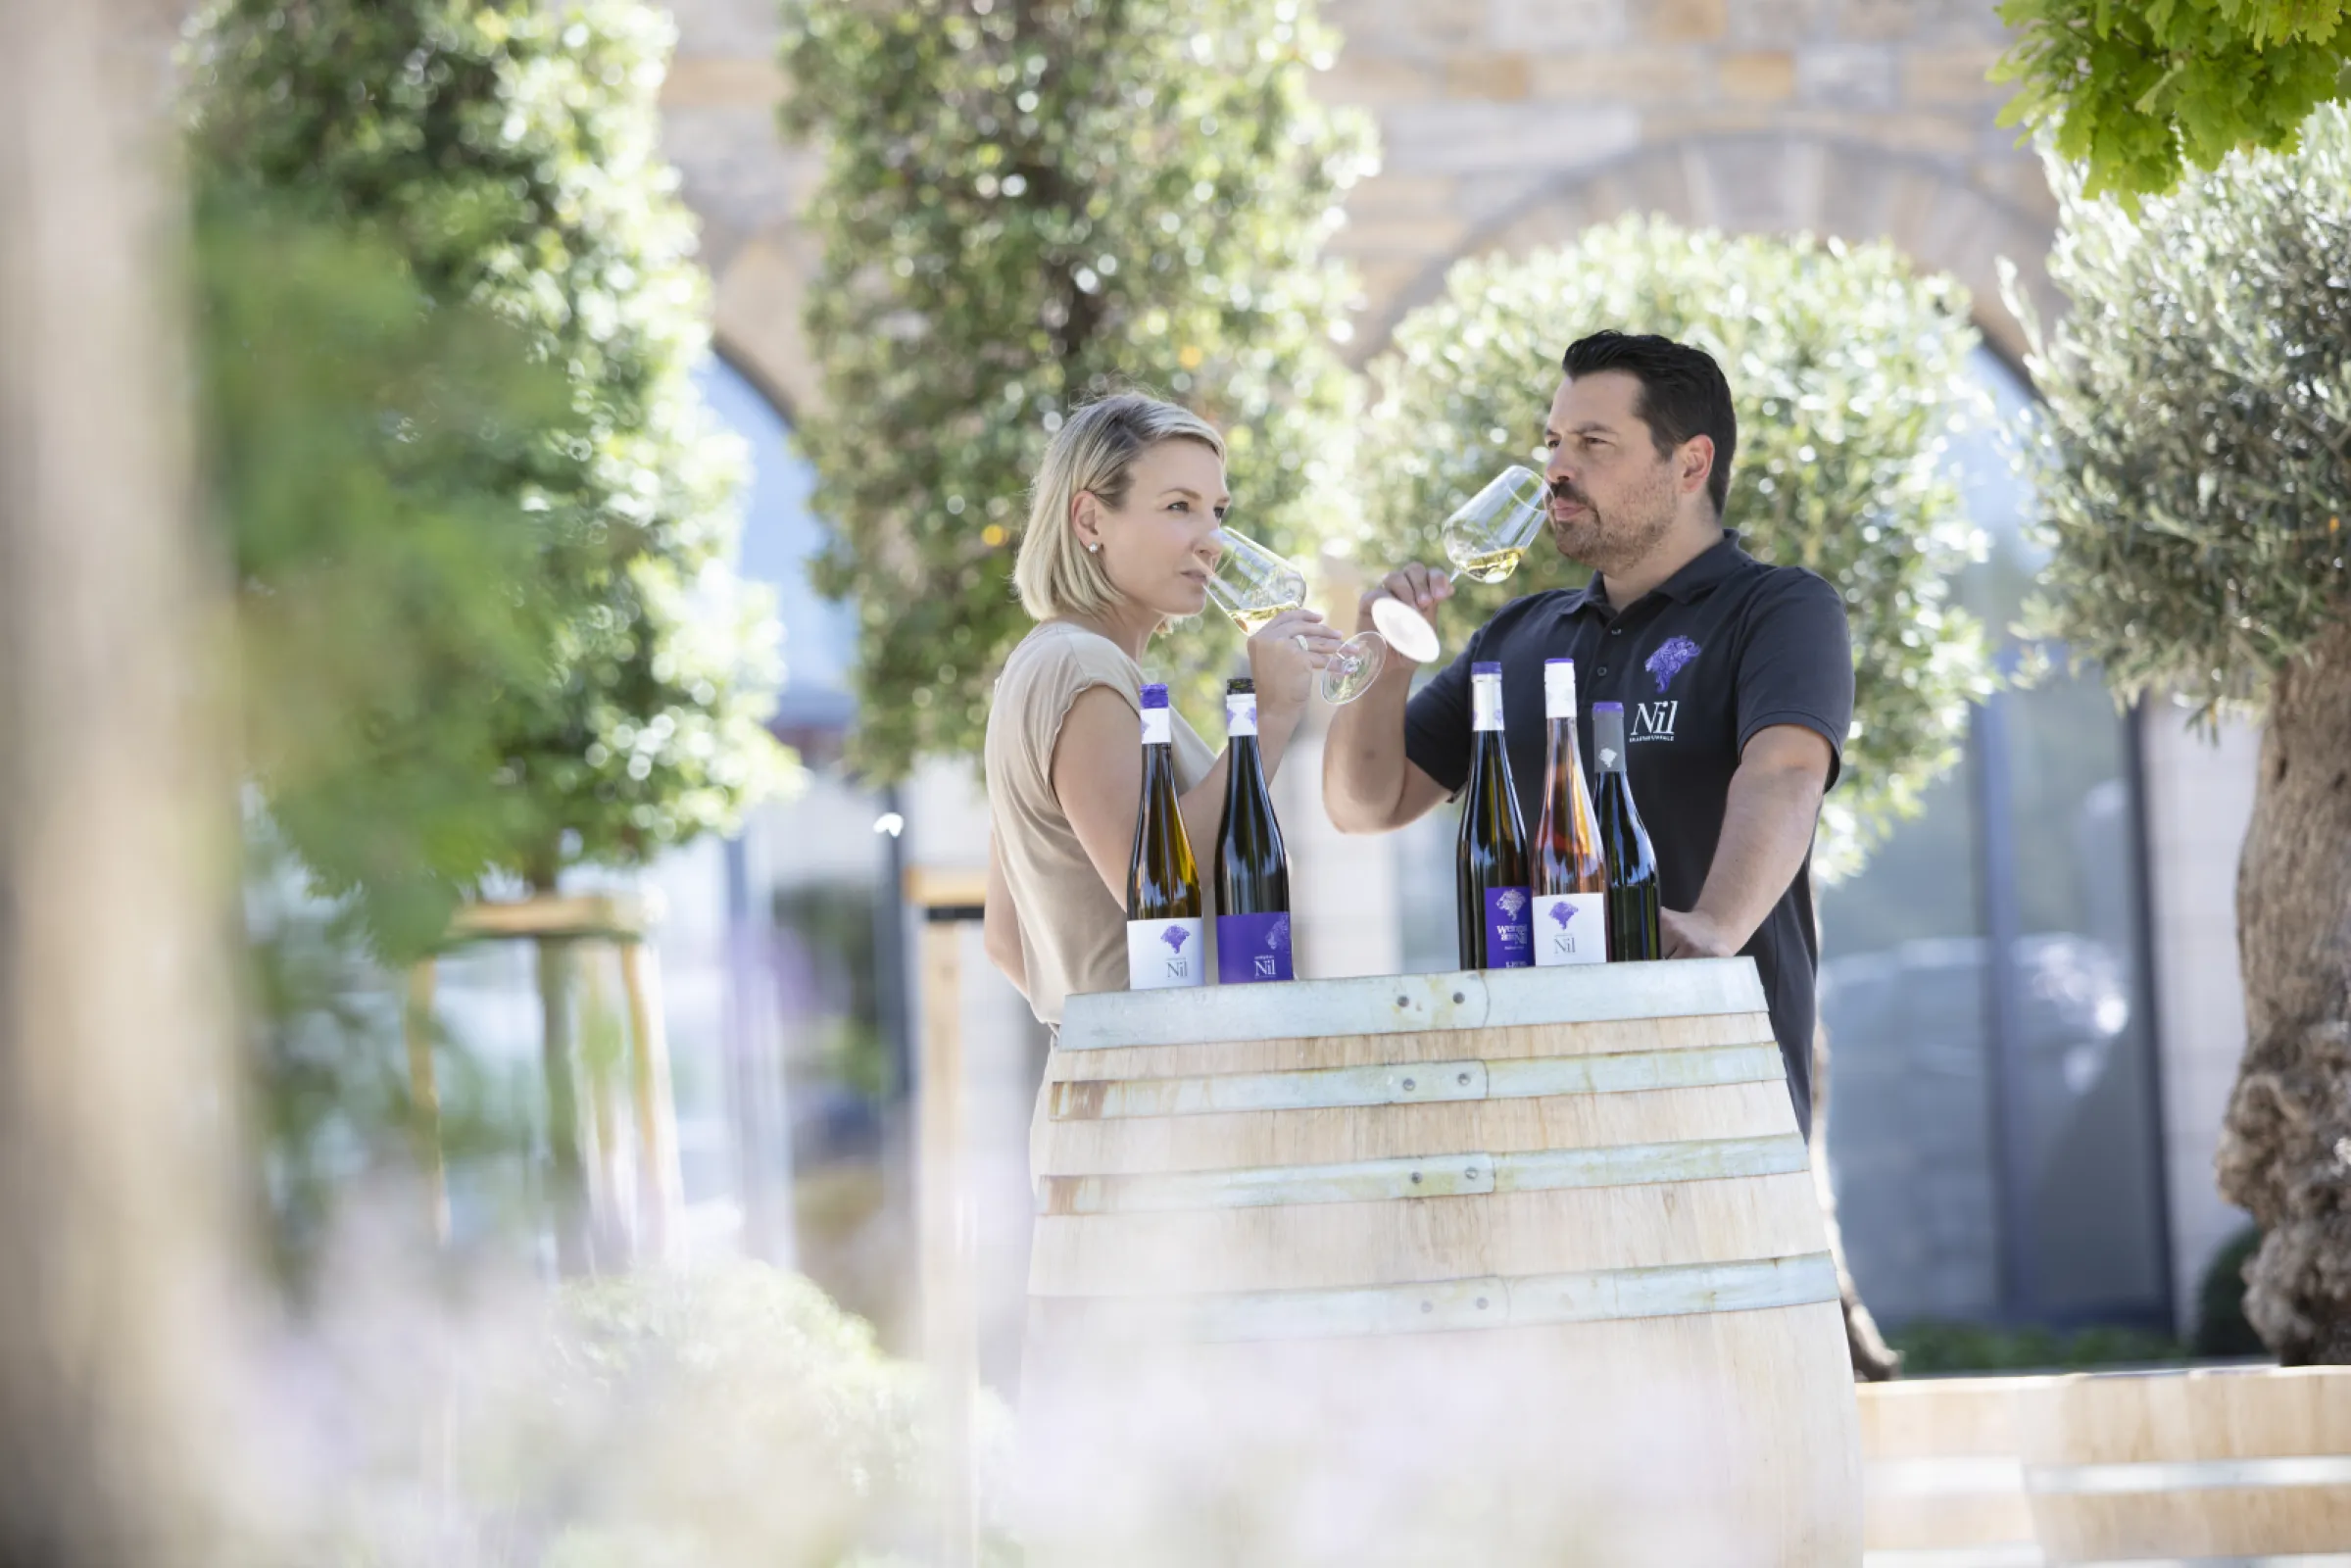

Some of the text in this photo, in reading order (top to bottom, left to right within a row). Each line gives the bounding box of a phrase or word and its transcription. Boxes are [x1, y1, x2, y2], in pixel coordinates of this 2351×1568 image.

[1630, 701, 1678, 735] Nil
[1553, 937, 1576, 955] Nil
[1165, 960, 1188, 978] Nil
[1253, 958, 1276, 977] Nil
